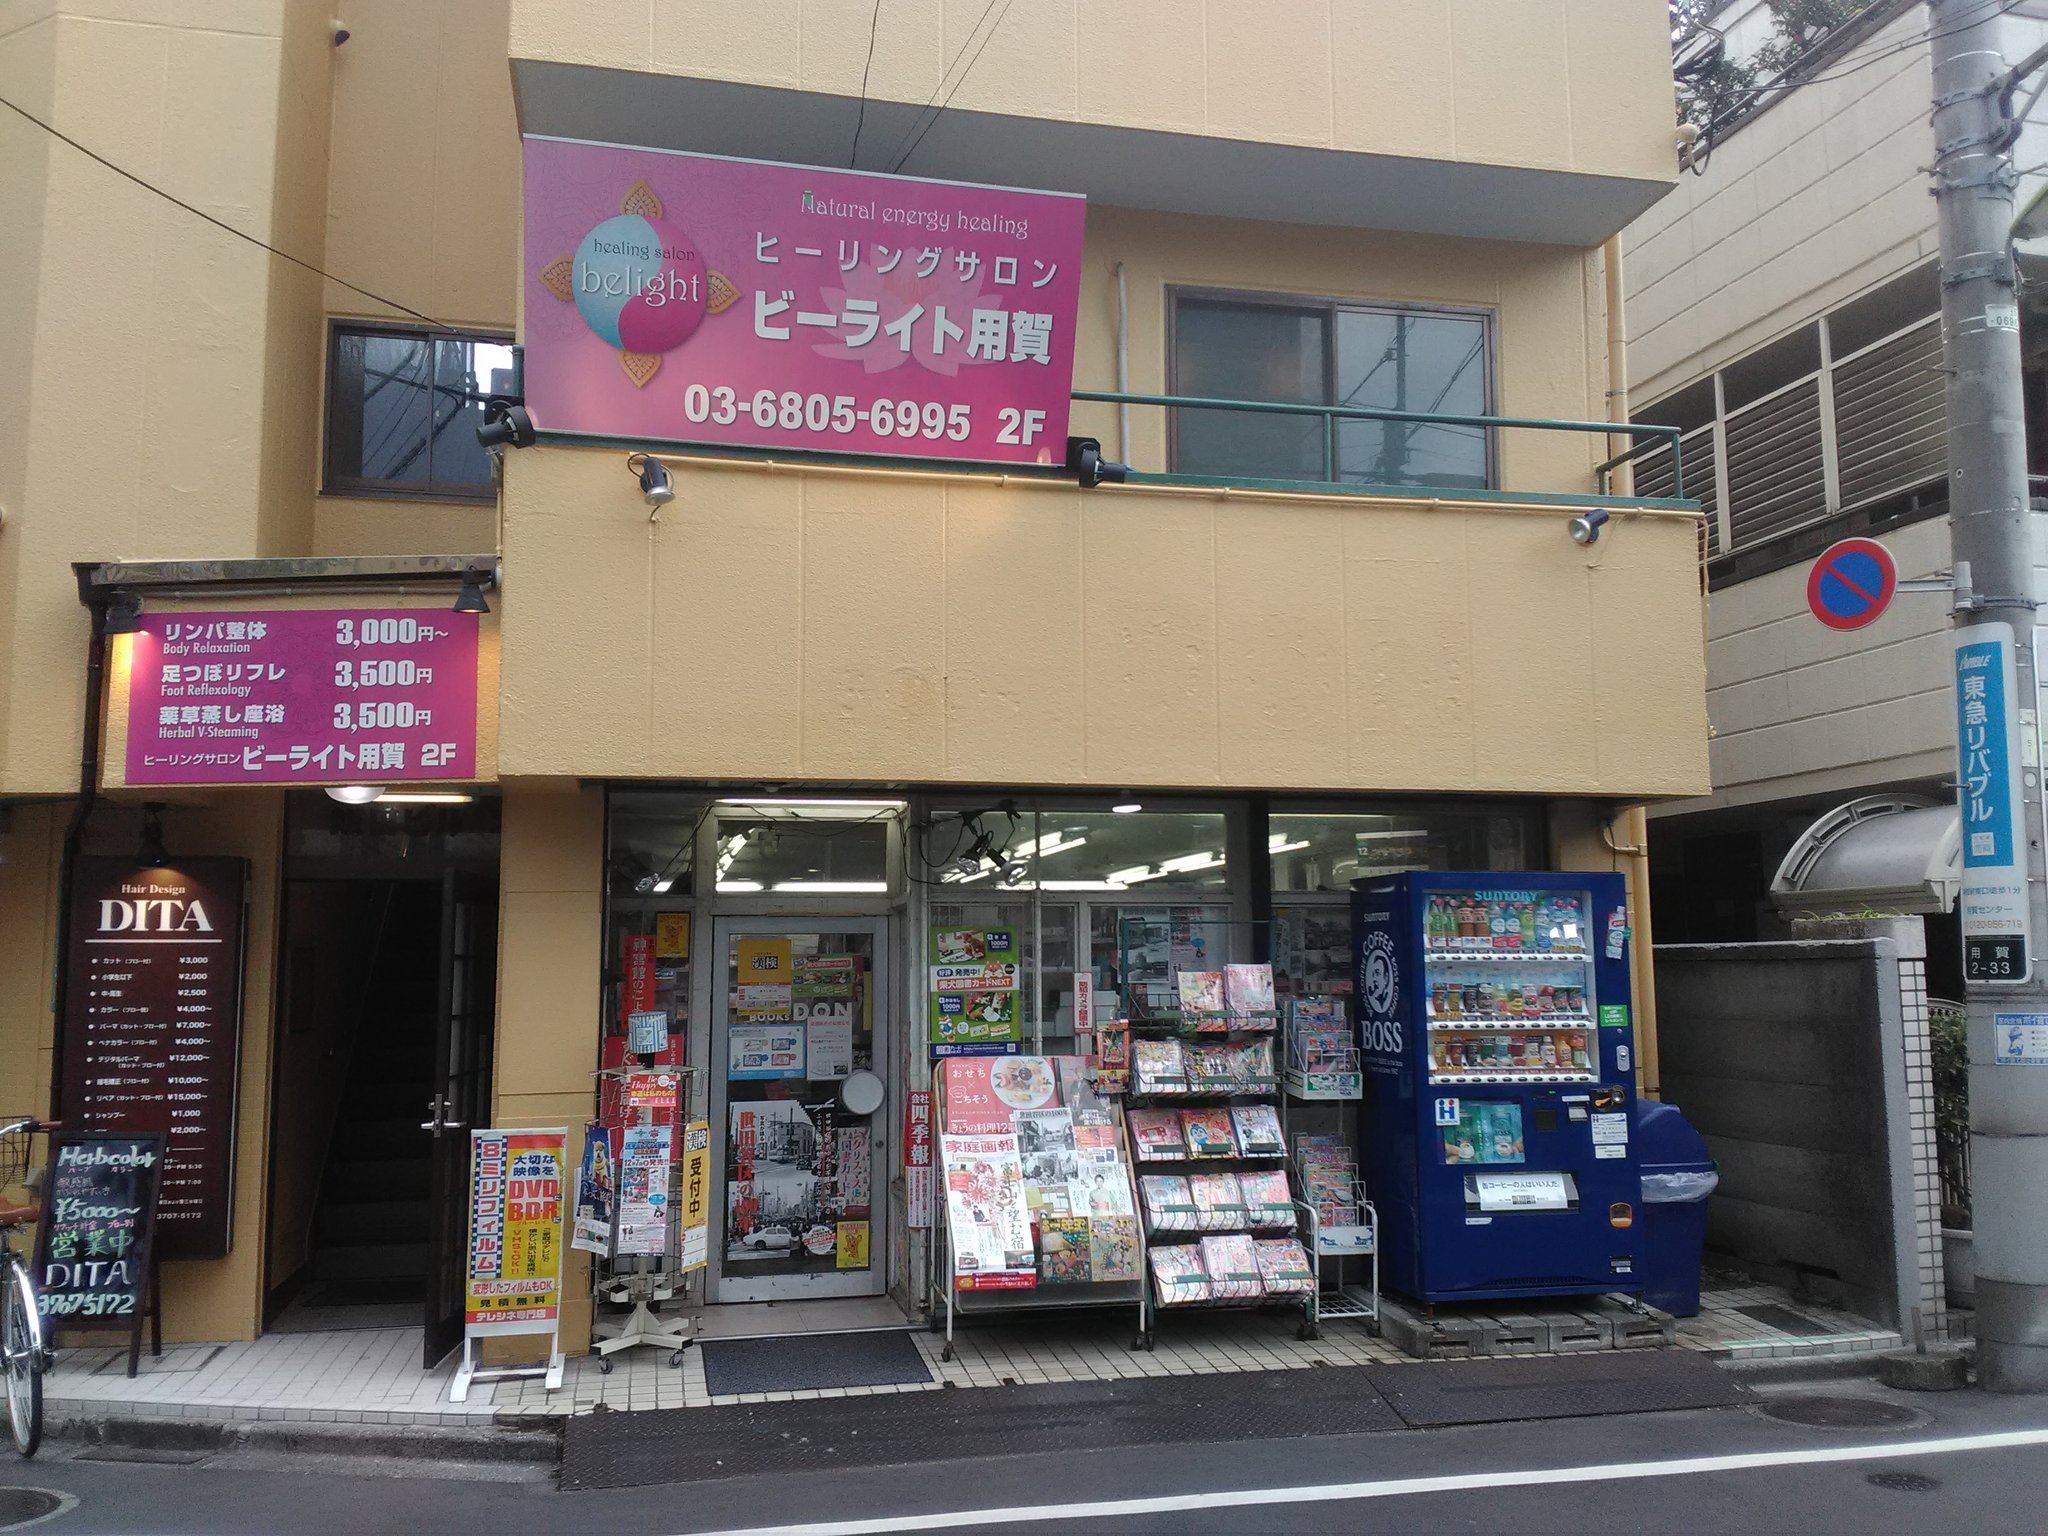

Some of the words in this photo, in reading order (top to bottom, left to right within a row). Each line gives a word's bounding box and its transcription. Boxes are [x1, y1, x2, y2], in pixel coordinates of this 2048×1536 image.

[883, 204, 951, 233] energy
[957, 209, 1029, 239] healing
[593, 237, 650, 259] healing
[655, 242, 696, 262] salon
[756, 231, 1057, 288] ヒーリングサロン
[581, 261, 701, 307] belight
[753, 289, 1054, 366] ビーライト用賀
[684, 383, 971, 441] 03-6805-6995
[996, 407, 1047, 447] 2F
[165, 621, 267, 640] リンパ整体
[163, 642, 190, 655] Body
[192, 641, 250, 654] Relaxation
[161, 664, 286, 683] 足つぼリフレ
[334, 660, 433, 692] 3,500円
[161, 684, 185, 697] Foot
[187, 683, 252, 698] Reflexology
[159, 705, 286, 725] 薬草蒸し座浴
[333, 702, 433, 734] 3,500円
[159, 726, 195, 739] Herbal
[197, 725, 259, 740] V-Steaming
[421, 743, 457, 766] 2F
[1964, 676, 1994, 823] 東急リバブル
[122, 884, 147, 894] Hair
[150, 884, 186, 895] Design
[1474, 890, 1538, 901] SUNTORY
[97, 900, 214, 931] DITA
[1363, 931, 1394, 955] COFFEE
[1971, 947, 2010, 959] 用賀
[1972, 962, 2010, 974] 2-33
[749, 1013, 790, 1022] BOOKS
[1361, 1020, 1403, 1053] BOSS
[953, 1069, 986, 1078] おせち
[911, 1094, 929, 1104] 会社
[911, 1105, 929, 1164] 四季報
[946, 1140, 1015, 1152] 家庭画報
[57, 1145, 156, 1168] Herbcolor
[514, 1155, 555, 1165] 大切な
[513, 1166, 554, 1177] 映像を
[689, 1156, 702, 1218] 受付中
[477, 1143, 500, 1269] 8ミリフィルム
[51, 1229, 134, 1258] 営業中
[46, 1260, 131, 1288] DITA
